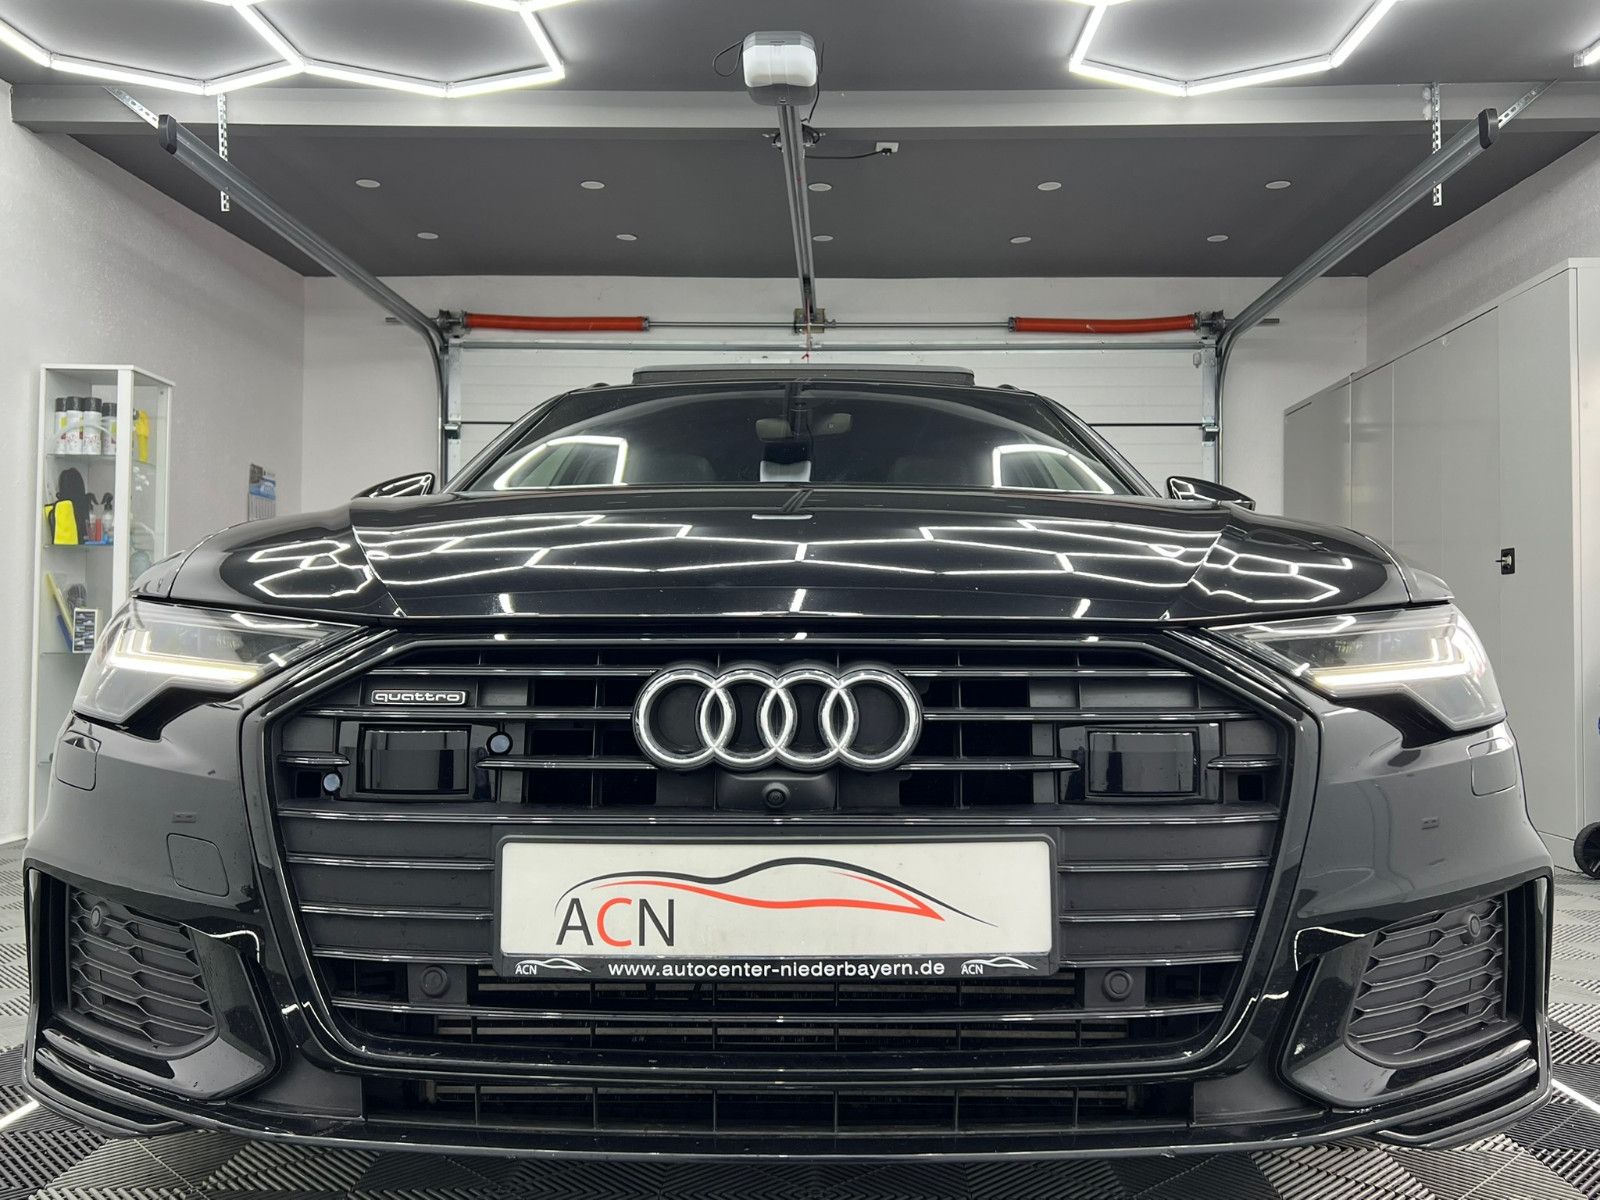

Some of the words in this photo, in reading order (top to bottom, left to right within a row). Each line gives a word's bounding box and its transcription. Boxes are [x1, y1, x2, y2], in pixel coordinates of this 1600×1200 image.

[375, 692, 460, 702] quattro
[556, 897, 675, 947] ACN
[515, 964, 537, 975] ACN
[608, 960, 945, 979] www.autocenter-niederbayern.de
[961, 964, 984, 975] ACN
